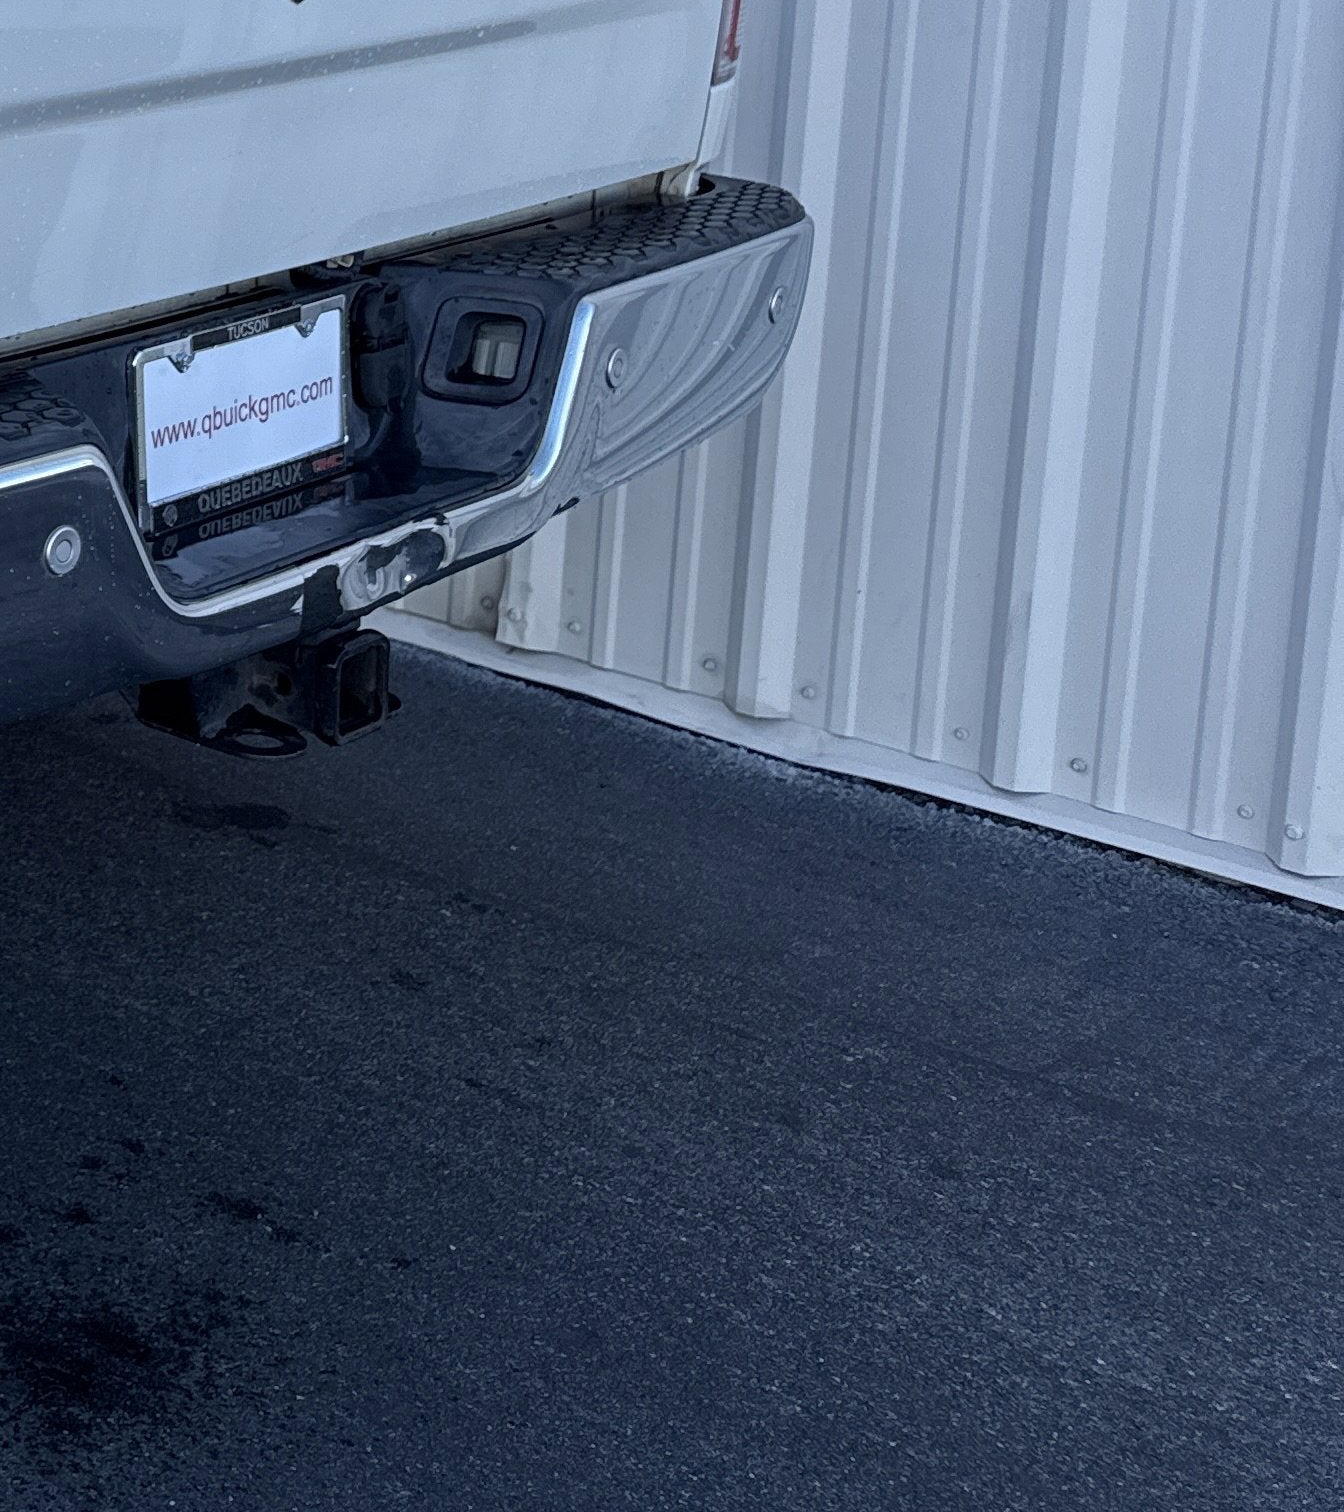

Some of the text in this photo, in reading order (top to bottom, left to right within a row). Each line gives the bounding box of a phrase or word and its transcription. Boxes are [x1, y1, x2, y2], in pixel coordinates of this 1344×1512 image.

[227, 317, 270, 341] TUCSON
[151, 376, 334, 449] www.qbuickgmc.com
[198, 462, 304, 513] QUEBEDEAUX
